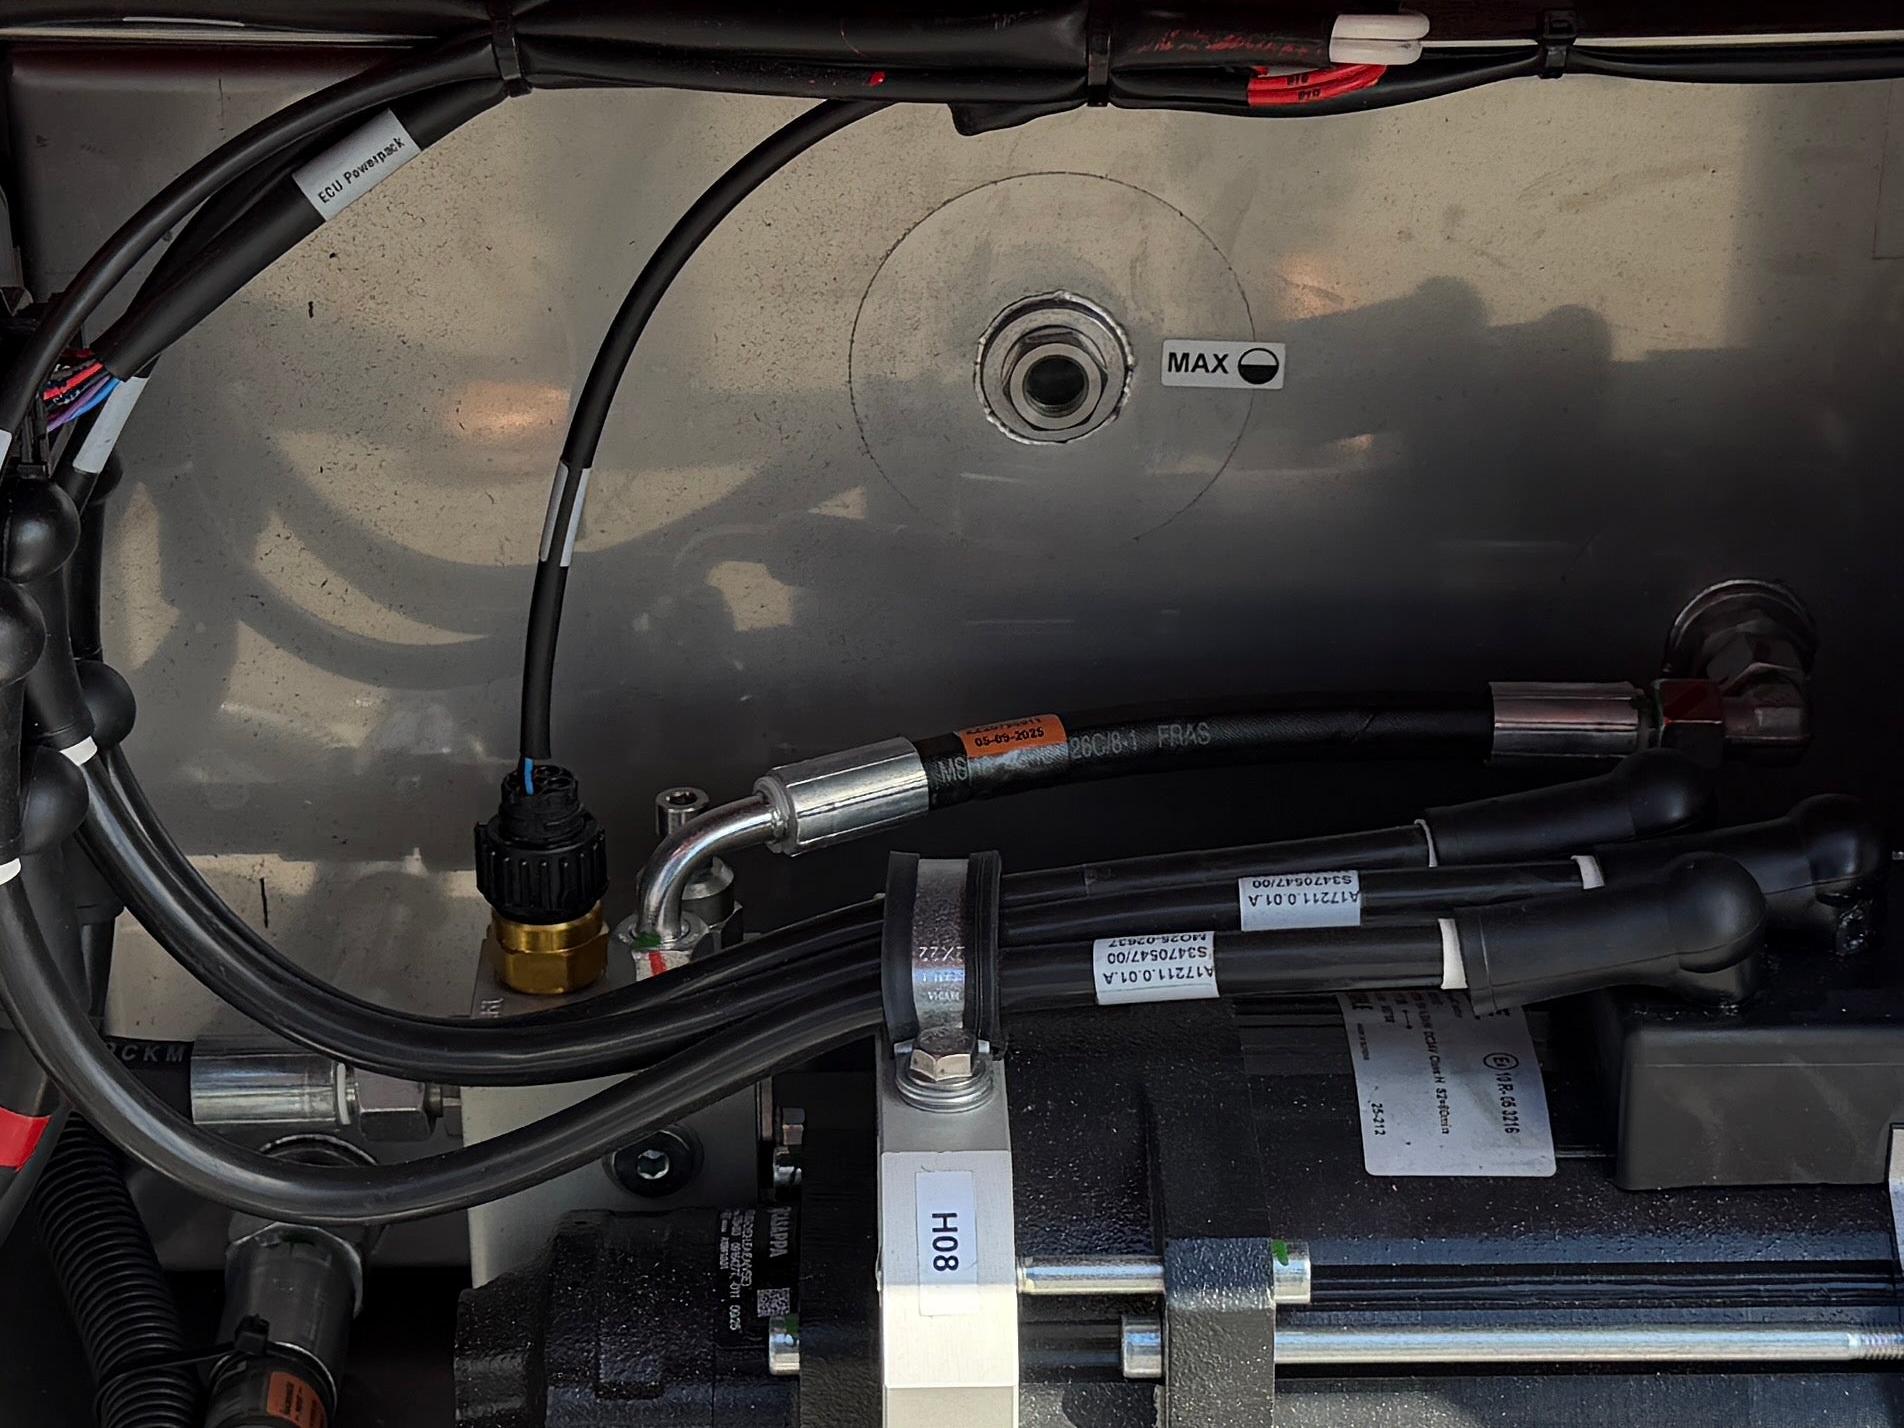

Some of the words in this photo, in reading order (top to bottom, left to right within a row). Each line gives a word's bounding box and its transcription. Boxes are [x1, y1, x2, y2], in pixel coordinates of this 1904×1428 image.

[317, 179, 343, 204] ECU
[343, 137, 405, 184] Powerpack
[1167, 351, 1230, 375] MAX
[1156, 722, 1212, 748] FRAS
[1252, 875, 1353, 890] S3470547/00
[1248, 890, 1361, 908] A17211.0.01.A
[1107, 945, 1208, 965] S3470547/00
[1102, 965, 1215, 985] A17211.0.01.A
[930, 1212, 959, 1273] H08
